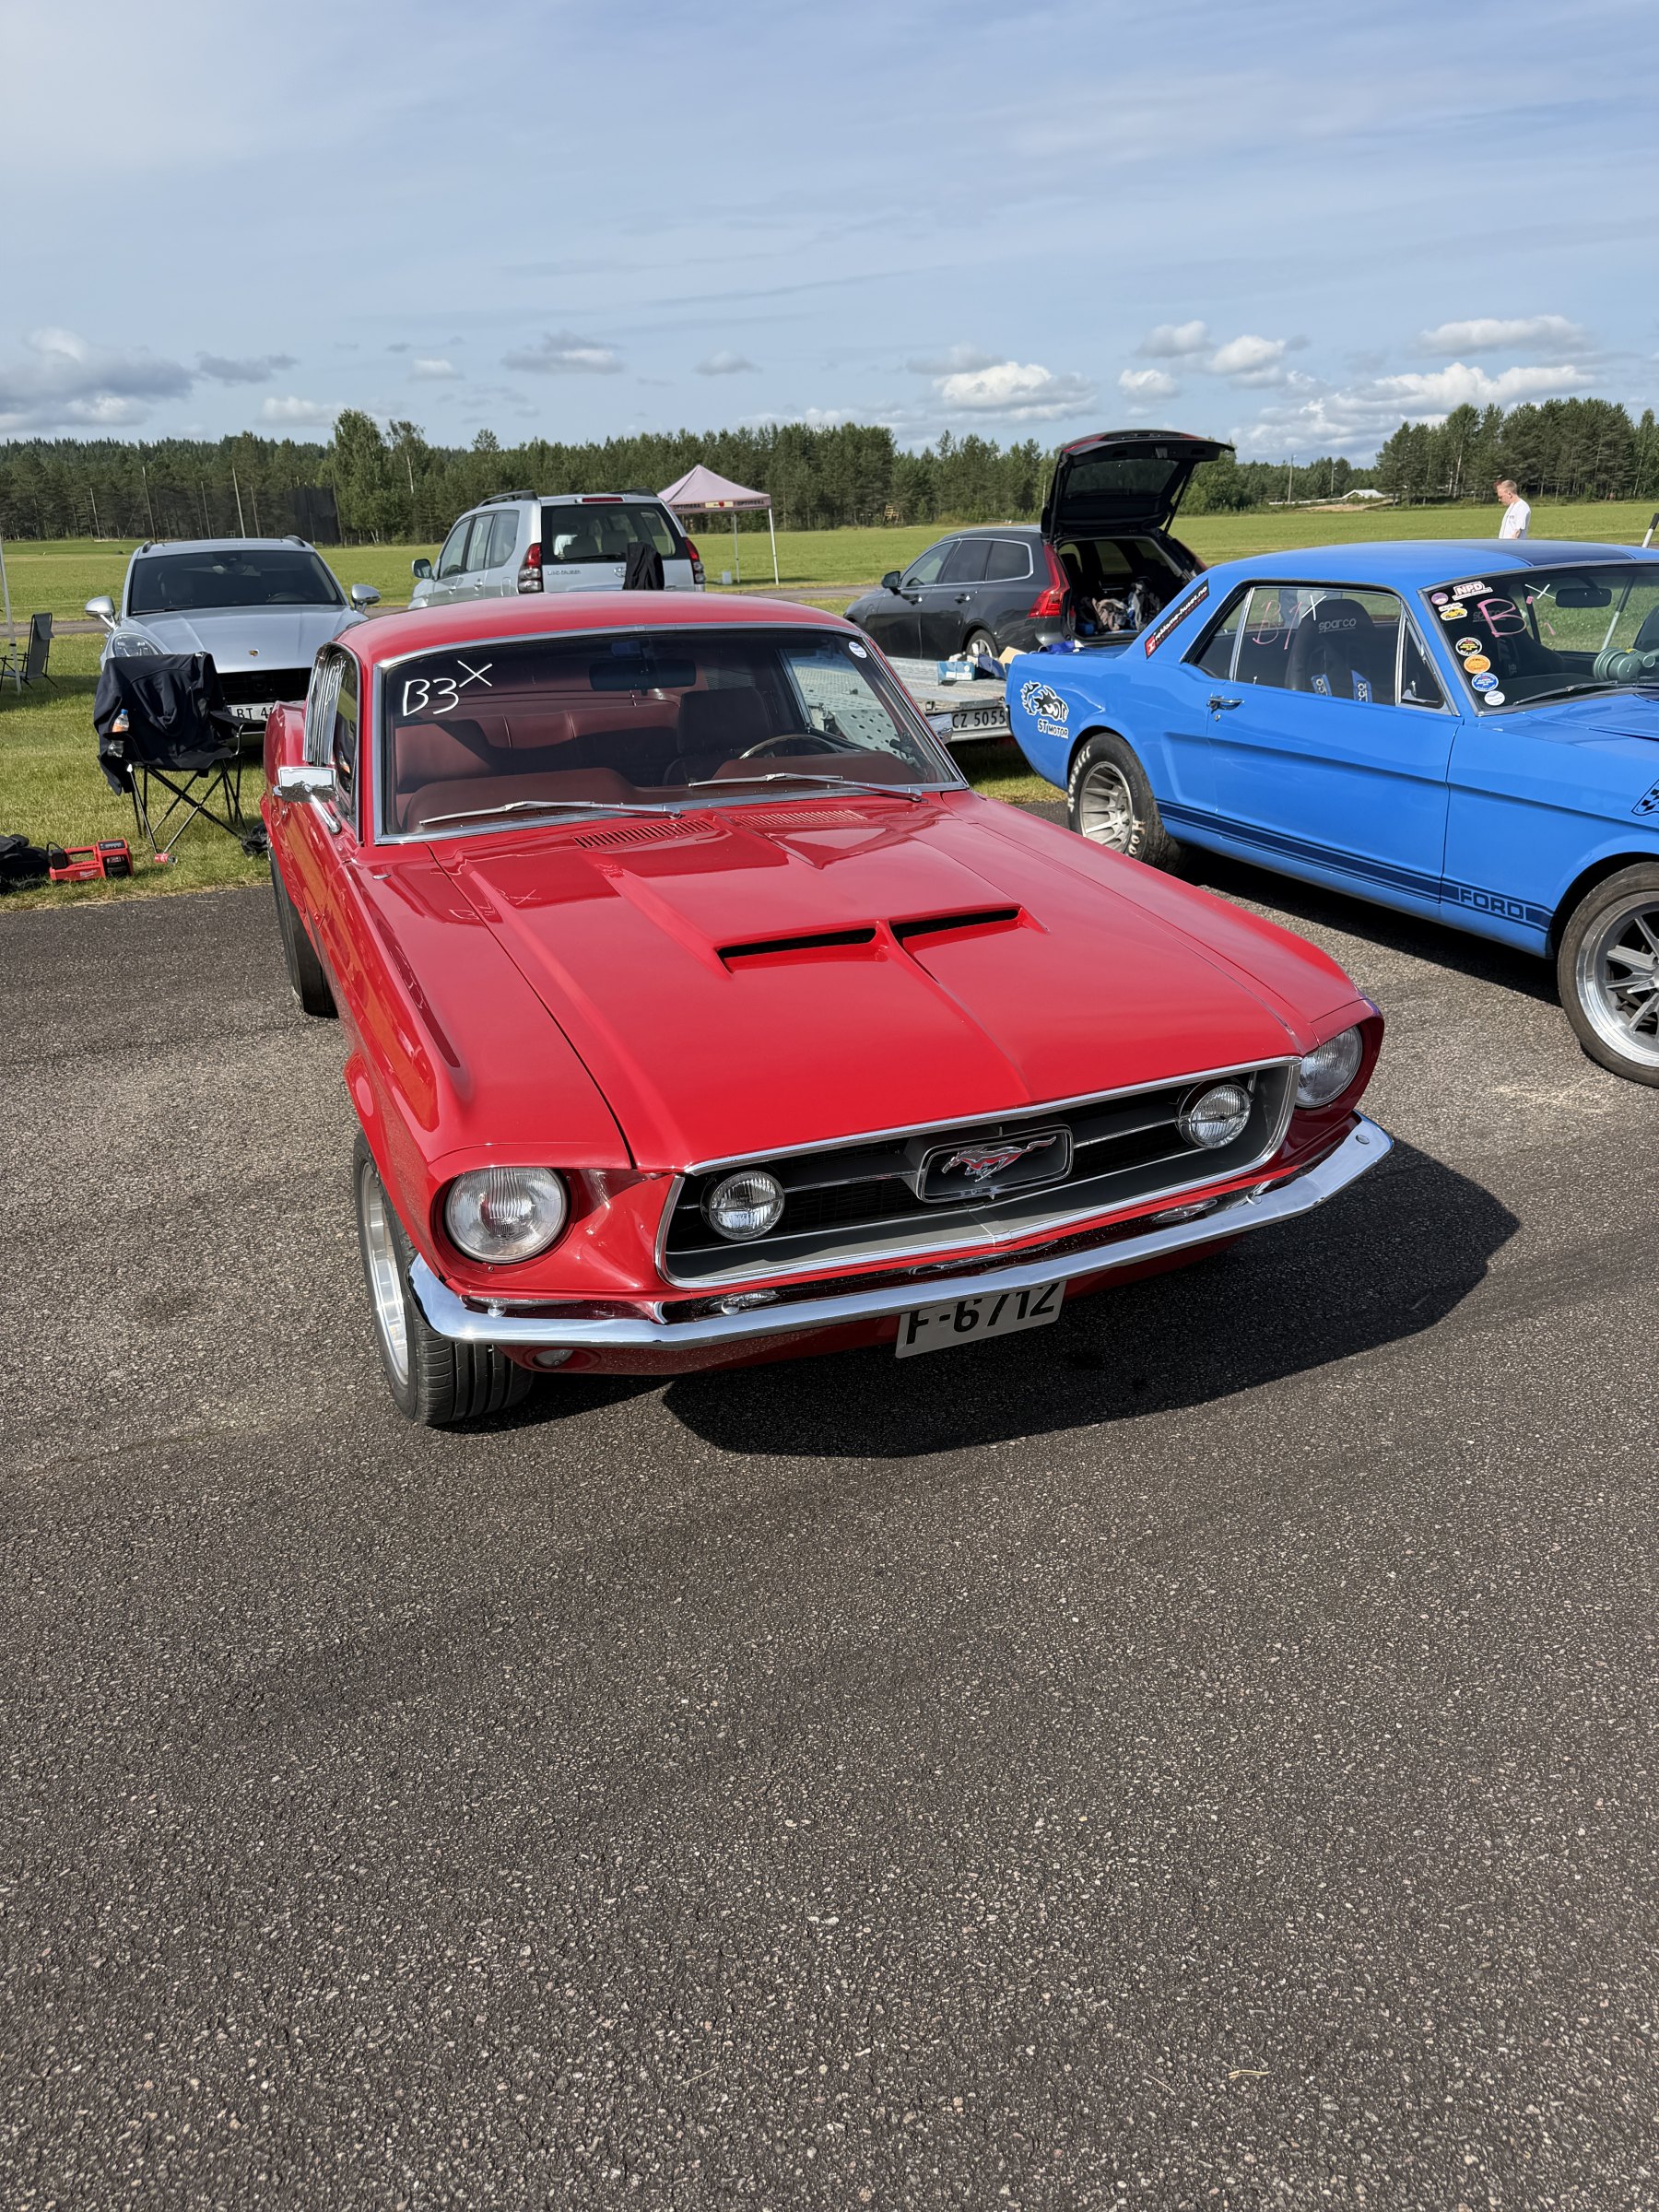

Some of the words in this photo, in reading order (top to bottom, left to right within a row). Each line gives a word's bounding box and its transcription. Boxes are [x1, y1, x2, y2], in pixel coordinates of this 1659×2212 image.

[1318, 618, 1357, 632] sparco
[952, 713, 968, 729] CZ
[974, 710, 1006, 726] 5055
[1038, 719, 1049, 733] ST
[1048, 724, 1068, 738] MOTOR
[1460, 888, 1524, 920] FORD
